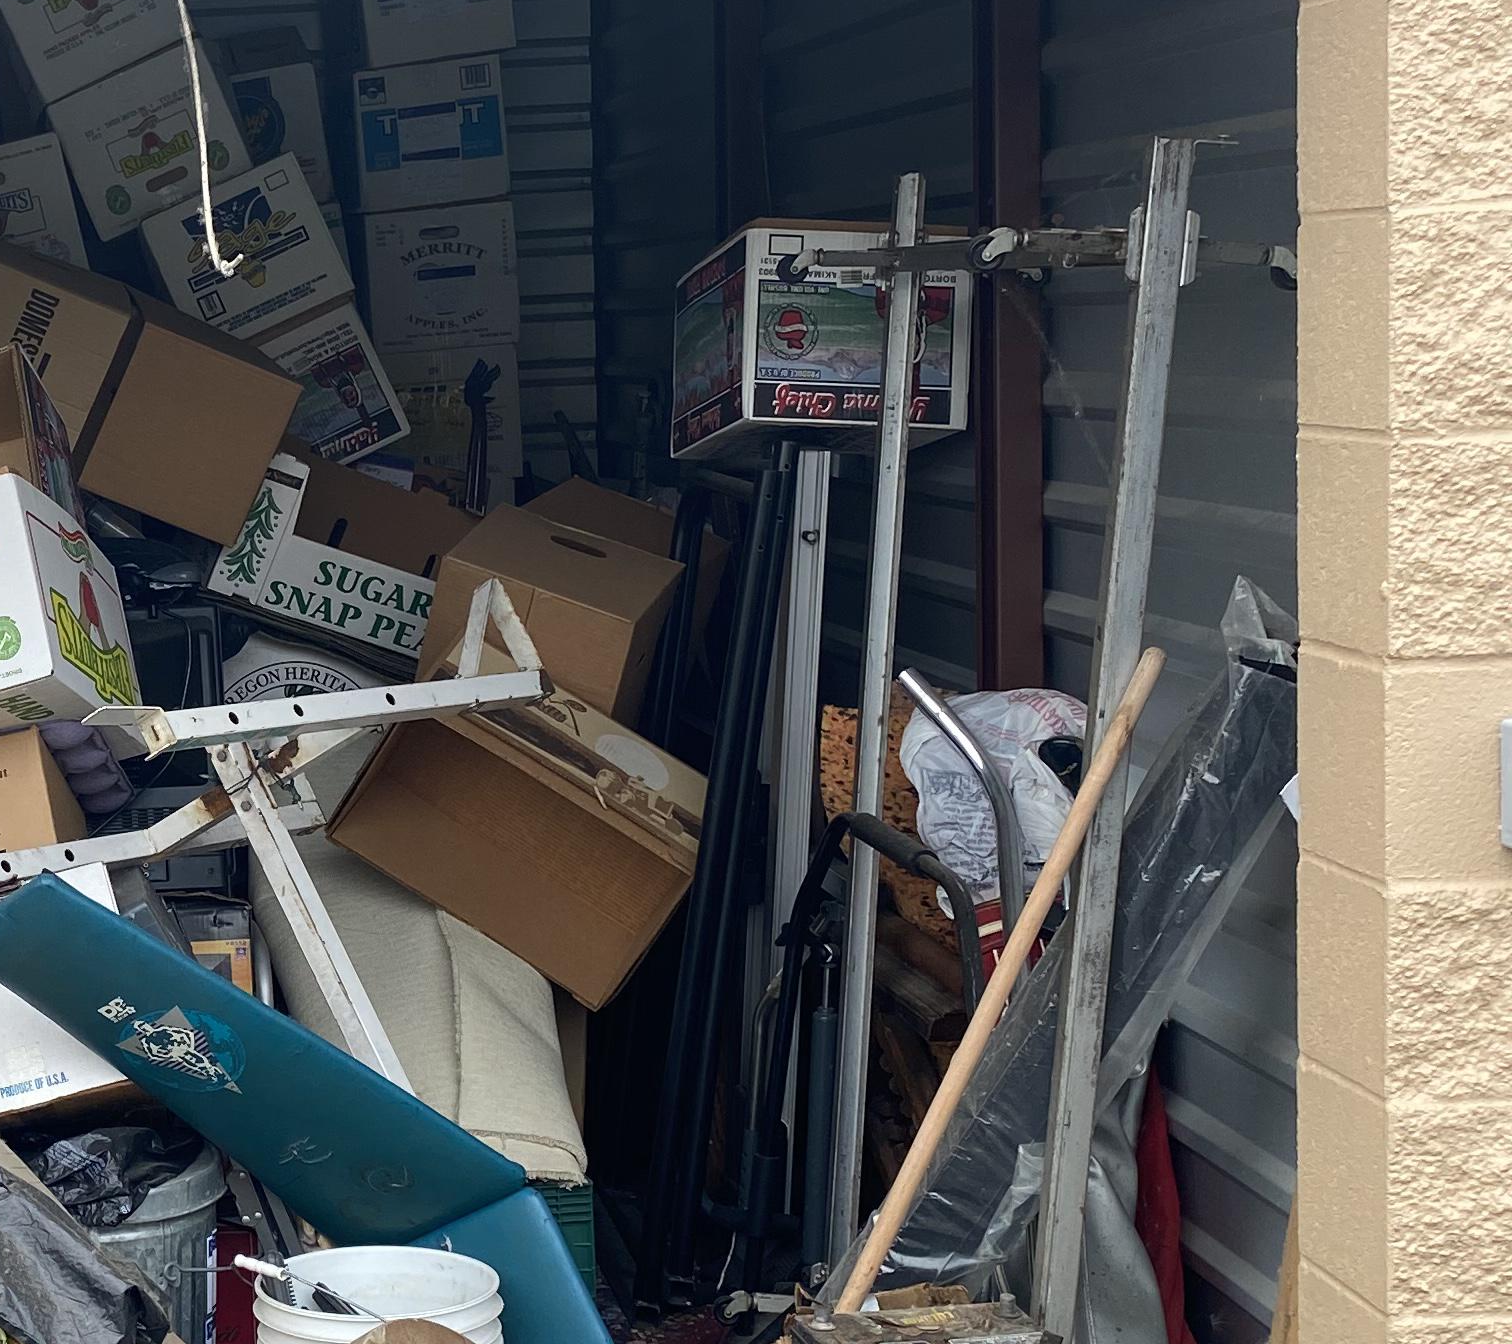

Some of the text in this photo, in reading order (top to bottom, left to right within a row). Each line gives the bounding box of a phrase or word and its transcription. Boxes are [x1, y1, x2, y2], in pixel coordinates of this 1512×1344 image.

[399, 241, 488, 267] MERRITT
[808, 269, 837, 279] AKIMA
[924, 274, 957, 283] BORTO
[10, 288, 60, 362] DOMES
[313, 560, 433, 619] SUGAR
[265, 580, 425, 652] SNAP PE
[225, 666, 356, 704] REGON HERITA
[0, 1079, 34, 1099] PRODUCE
[34, 1076, 45, 1091] OF
